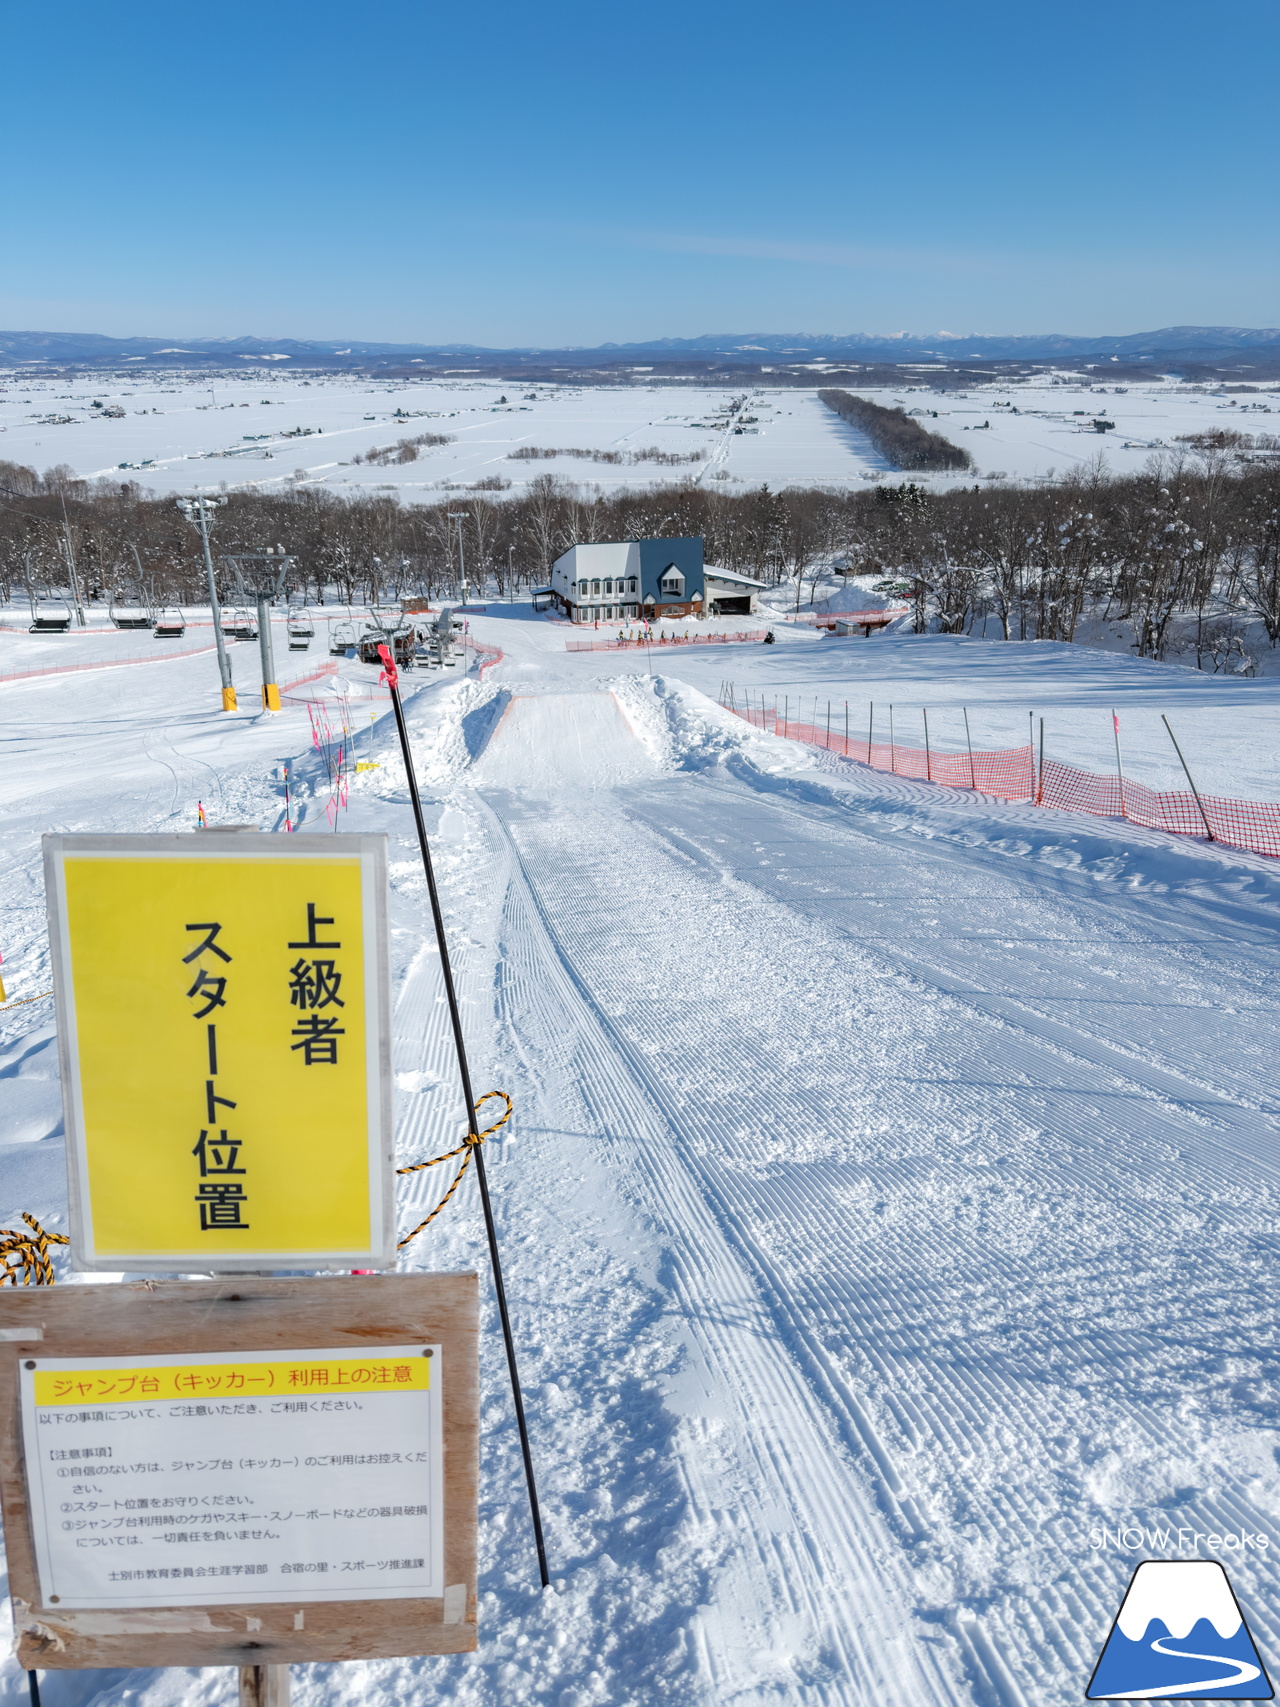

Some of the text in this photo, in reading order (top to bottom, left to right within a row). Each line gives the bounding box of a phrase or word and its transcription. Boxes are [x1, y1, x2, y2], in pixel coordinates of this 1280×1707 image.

[288, 902, 345, 1066] 上級者
[181, 922, 249, 1231] スタート位置
[53, 1366, 412, 1397] ジャンプ台（キッカー）利用上の注意
[49, 1446, 113, 1461] 【注意事項】
[72, 1484, 103, 1495] さい。
